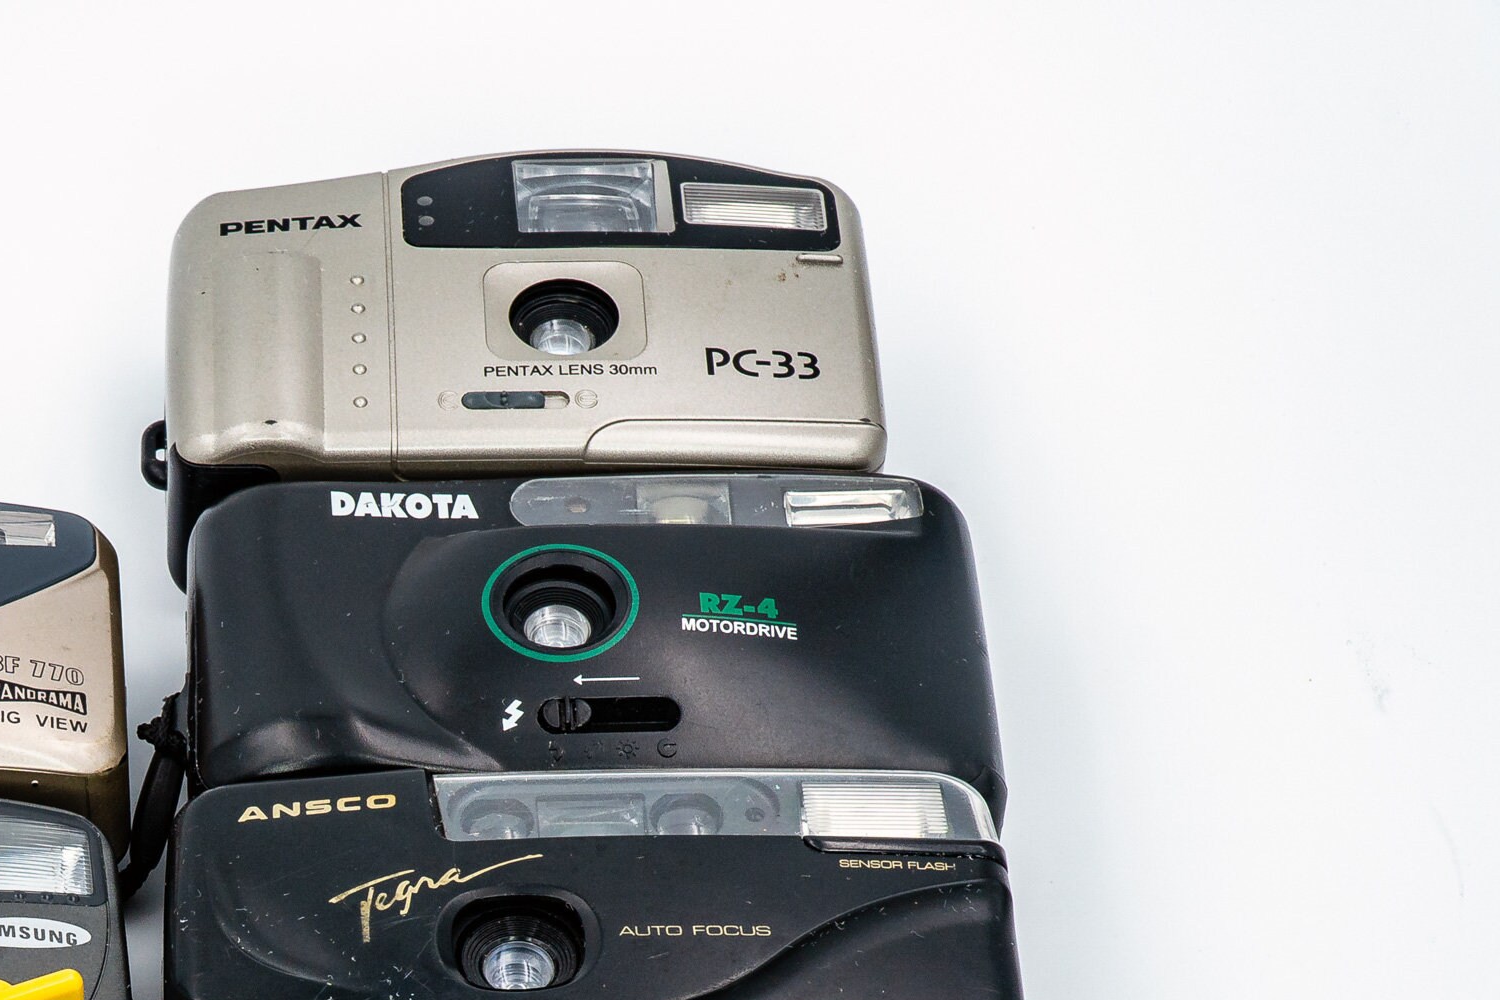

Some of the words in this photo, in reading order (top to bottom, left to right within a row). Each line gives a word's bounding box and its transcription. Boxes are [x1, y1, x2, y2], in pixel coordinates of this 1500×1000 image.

[220, 214, 362, 236] PENTAX
[483, 365, 553, 377] PENTAX
[559, 364, 604, 375] LENS
[609, 364, 657, 375] 30mm
[705, 347, 821, 380] PC-33
[330, 491, 479, 519] DAKOTA
[699, 592, 778, 618] RZ-4
[682, 618, 798, 640] MOTORDRIVE
[30, 660, 84, 686] 770
[36, 714, 88, 733] VIEW
[238, 794, 396, 822] ANSCO
[839, 859, 903, 869] SENSOR
[908, 861, 956, 871] FLASH
[328, 854, 544, 943] Tegra
[619, 925, 682, 936] AUTO
[693, 925, 771, 936] FOCUS
